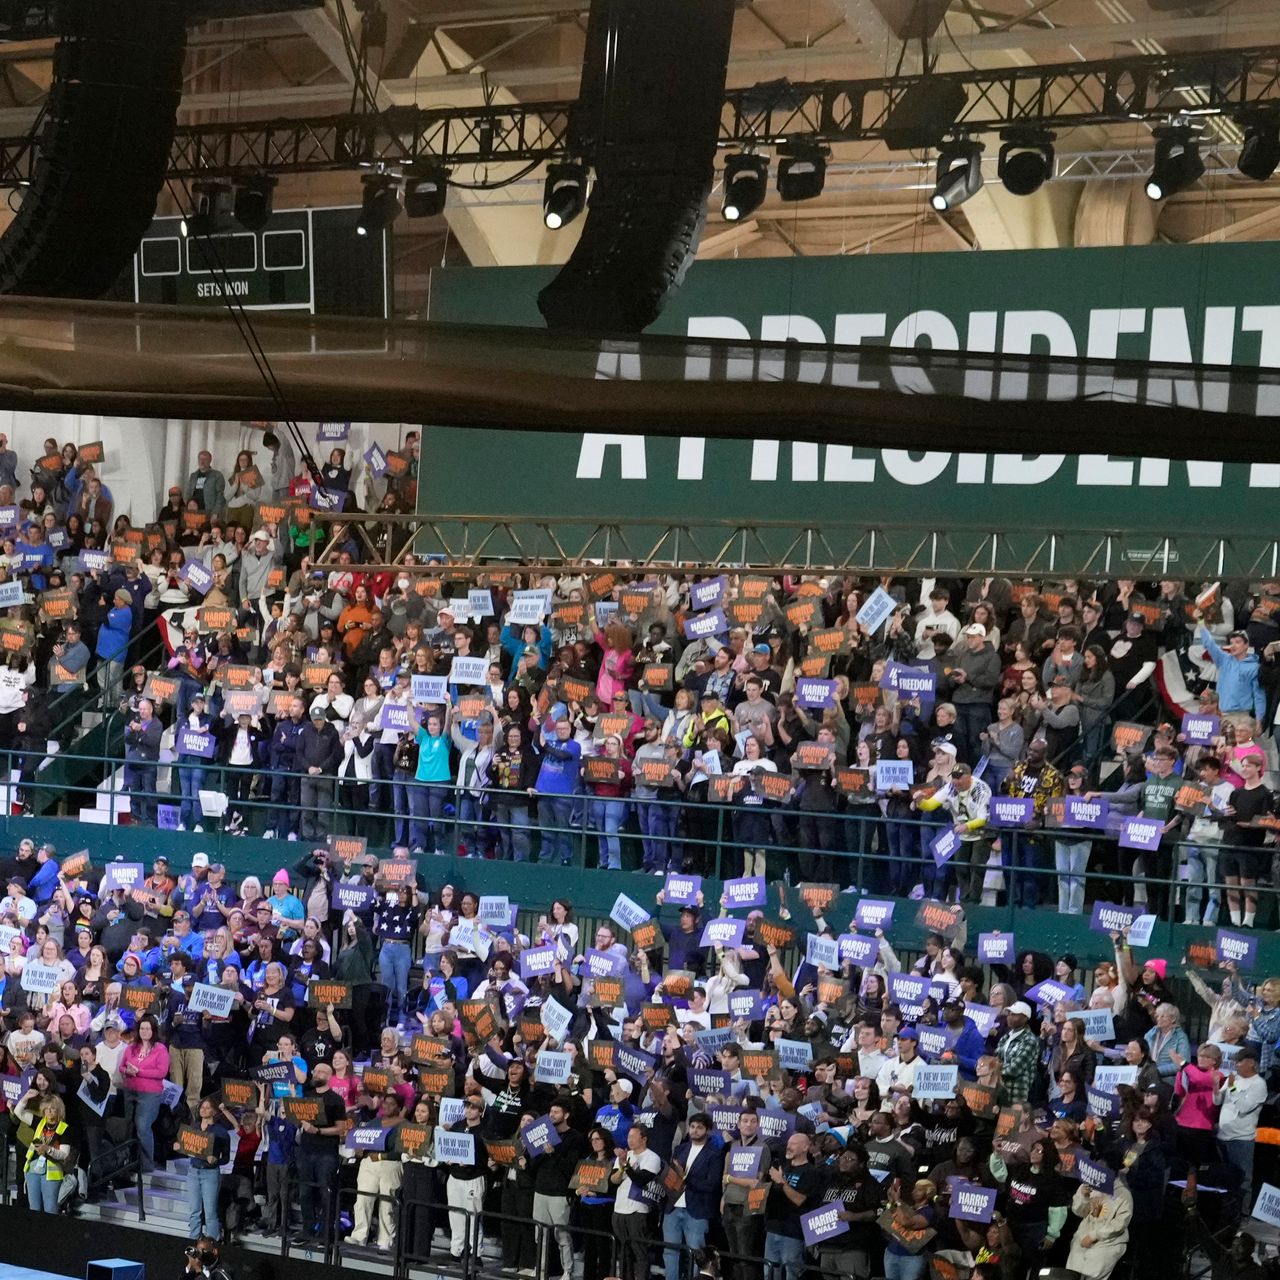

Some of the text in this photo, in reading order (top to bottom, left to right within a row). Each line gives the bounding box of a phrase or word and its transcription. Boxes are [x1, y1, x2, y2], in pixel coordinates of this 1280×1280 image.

[197, 281, 249, 297] SETS WON
[696, 583, 720, 597] HARRIS
[204, 612, 231, 622] HARRIS
[690, 616, 718, 631] HARRIS
[802, 684, 829, 696] HARRIS
[899, 678, 932, 691] FREEDOM
[805, 694, 824, 702] WALZ
[1187, 720, 1213, 732] HARRIS
[184, 733, 209, 746] HARRIS
[1191, 730, 1209, 739] WALZ
[186, 741, 204, 751] WALZ
[886, 767, 910, 776] NEW WAY
[881, 774, 910, 784] FORWARD
[996, 803, 1025, 814] HARRIS
[1071, 802, 1101, 814] HARRIS
[1000, 813, 1021, 822] WALZ
[1076, 812, 1095, 822] WALZ
[1127, 823, 1156, 837] HARRIS
[1130, 833, 1151, 844] WALZ
[112, 869, 138, 879] HARRIS
[382, 863, 411, 875] HARRIS
[116, 876, 135, 884] WALZ
[668, 881, 693, 893] HARRIS
[670, 888, 688, 898] WALZ
[729, 884, 759, 897] HARRIS
[339, 890, 367, 901] HARRIS
[734, 893, 755, 901] WALZ
[342, 898, 361, 907] WALZ
[860, 906, 886, 917] HARRIS
[1099, 908, 1133, 923] HARRIS
[864, 914, 882, 924] WALZ
[708, 925, 736, 937] HARRIS
[841, 940, 871, 954] HARRIS
[983, 939, 1007, 951] HARRIS
[1221, 938, 1249, 952] HARRIS
[526, 949, 554, 964] HARRIS
[843, 949, 864, 959] WALZ
[987, 949, 1004, 958] WALZ
[1223, 948, 1243, 959] WALZ
[530, 961, 550, 970] WALZ
[589, 955, 613, 969] HARRIS
[31, 970, 58, 981] NEW WAY
[590, 965, 609, 976] WALZ
[25, 978, 57, 987] FORWARD
[595, 981, 621, 993] HARRIS
[893, 978, 923, 992] HARRIS
[125, 990, 155, 1002] HARRIS
[196, 990, 230, 1003] A NEW WAY
[314, 986, 347, 997] HARRIS
[896, 989, 917, 1000] WALZ
[195, 998, 226, 1011] FORWARD
[322, 995, 341, 1004] WALZ
[1094, 1016, 1107, 1024] WAY
[920, 1033, 946, 1046] HARRIS
[924, 1042, 941, 1053] WALZ
[618, 1050, 646, 1069] HARRIS
[743, 1054, 773, 1066] HARRIS
[694, 1074, 724, 1089] HARRIS
[917, 1073, 953, 1082] A NEW WAY
[3, 1080, 22, 1093] HARRIS
[224, 1085, 251, 1096] HARRIS
[699, 1084, 720, 1093] WALZ
[919, 1082, 949, 1091] FORWARD
[290, 1102, 319, 1114] HARRIS
[713, 1110, 740, 1122] HARRIS
[760, 1117, 787, 1131] HARRIS
[181, 1131, 209, 1147] HARRIS
[353, 1128, 383, 1139] HARRIS
[526, 1124, 549, 1143] HARRIS
[438, 1138, 471, 1149] A NEW WAY
[440, 1147, 469, 1157] FORWARD
[732, 1153, 756, 1165] HARRIS
[578, 1164, 606, 1177] HARRIS
[733, 1163, 750, 1172] WALZ
[1079, 1160, 1107, 1183] HARRIS
[958, 1191, 988, 1207] HARRIS
[961, 1205, 982, 1215] WALZ
[808, 1209, 839, 1231] HARRIS
[815, 1221, 838, 1236] WALZ
